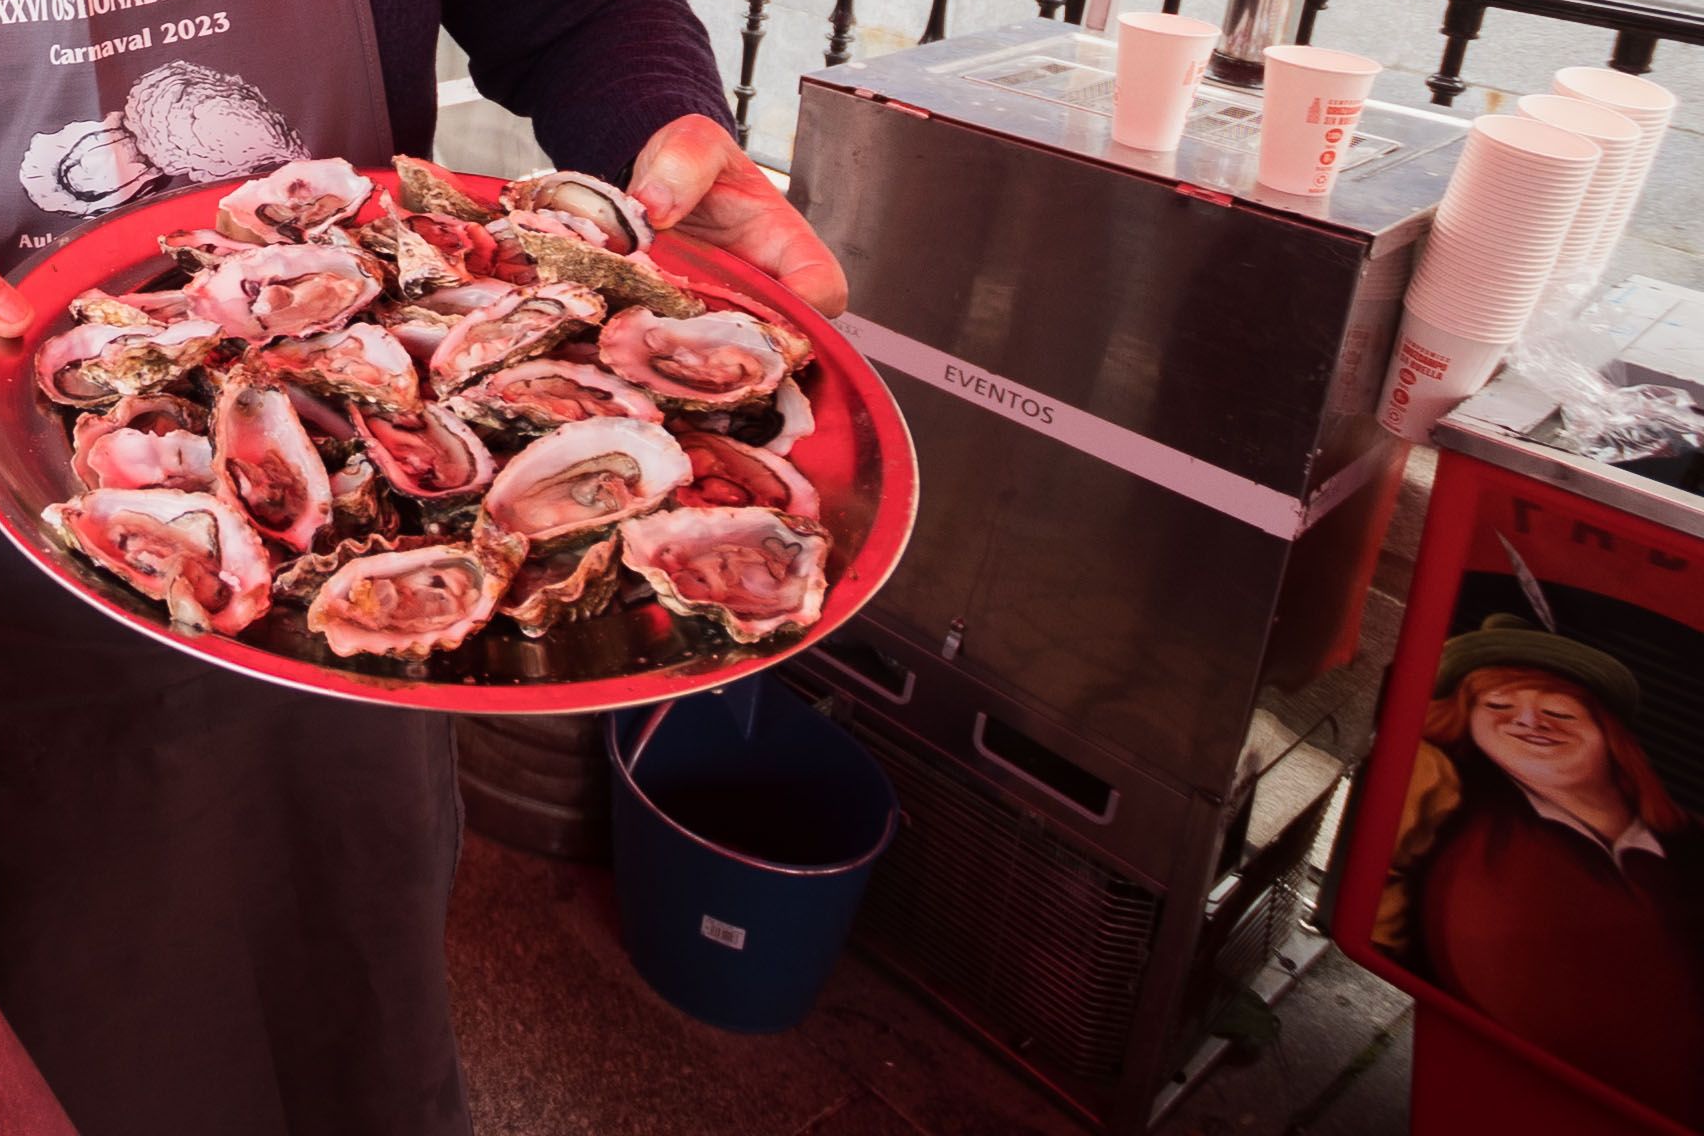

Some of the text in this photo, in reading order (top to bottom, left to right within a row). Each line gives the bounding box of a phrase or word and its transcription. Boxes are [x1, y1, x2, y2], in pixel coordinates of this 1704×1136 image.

[49, 11, 231, 65] Carnaval 2023
[944, 364, 1055, 425] EVENTOS
